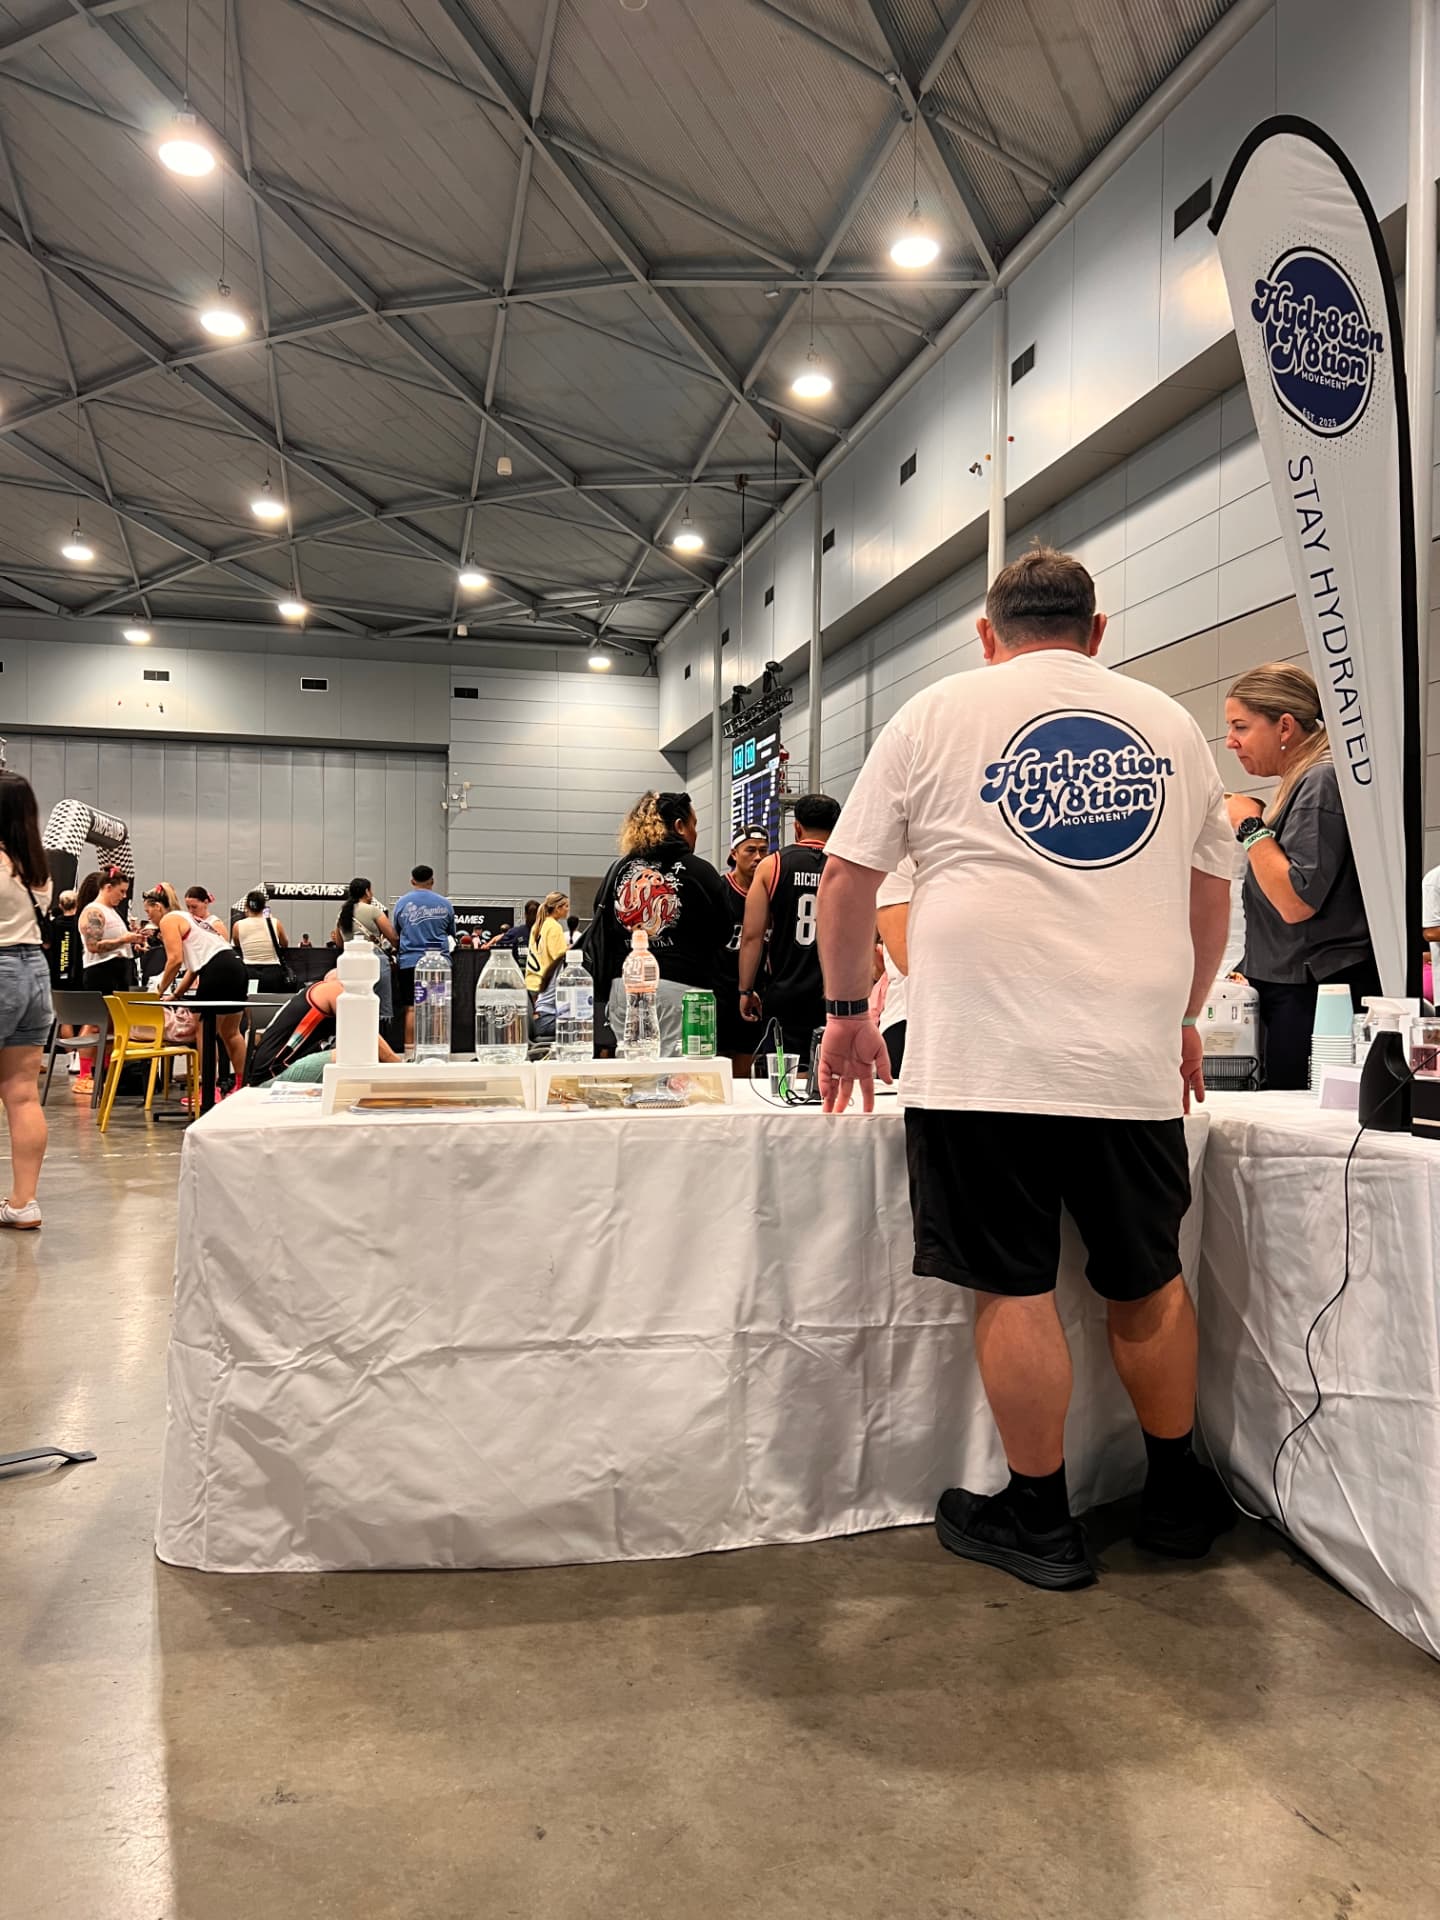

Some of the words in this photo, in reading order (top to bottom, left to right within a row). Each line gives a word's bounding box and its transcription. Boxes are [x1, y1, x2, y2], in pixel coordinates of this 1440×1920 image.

[1251, 279, 1384, 353] Hydr8tion
[1270, 328, 1368, 386] N8tion
[1301, 370, 1347, 391] MOVEMENT
[1302, 407, 1317, 424] EST.
[1319, 416, 1337, 428] 2025
[1288, 455, 1331, 552] STAY
[1310, 567, 1373, 786] HYDRATED
[980, 745, 1175, 804] Hydr8tion
[1061, 811, 1129, 827] MOVEMENT
[274, 883, 346, 896] TURFGAMES
